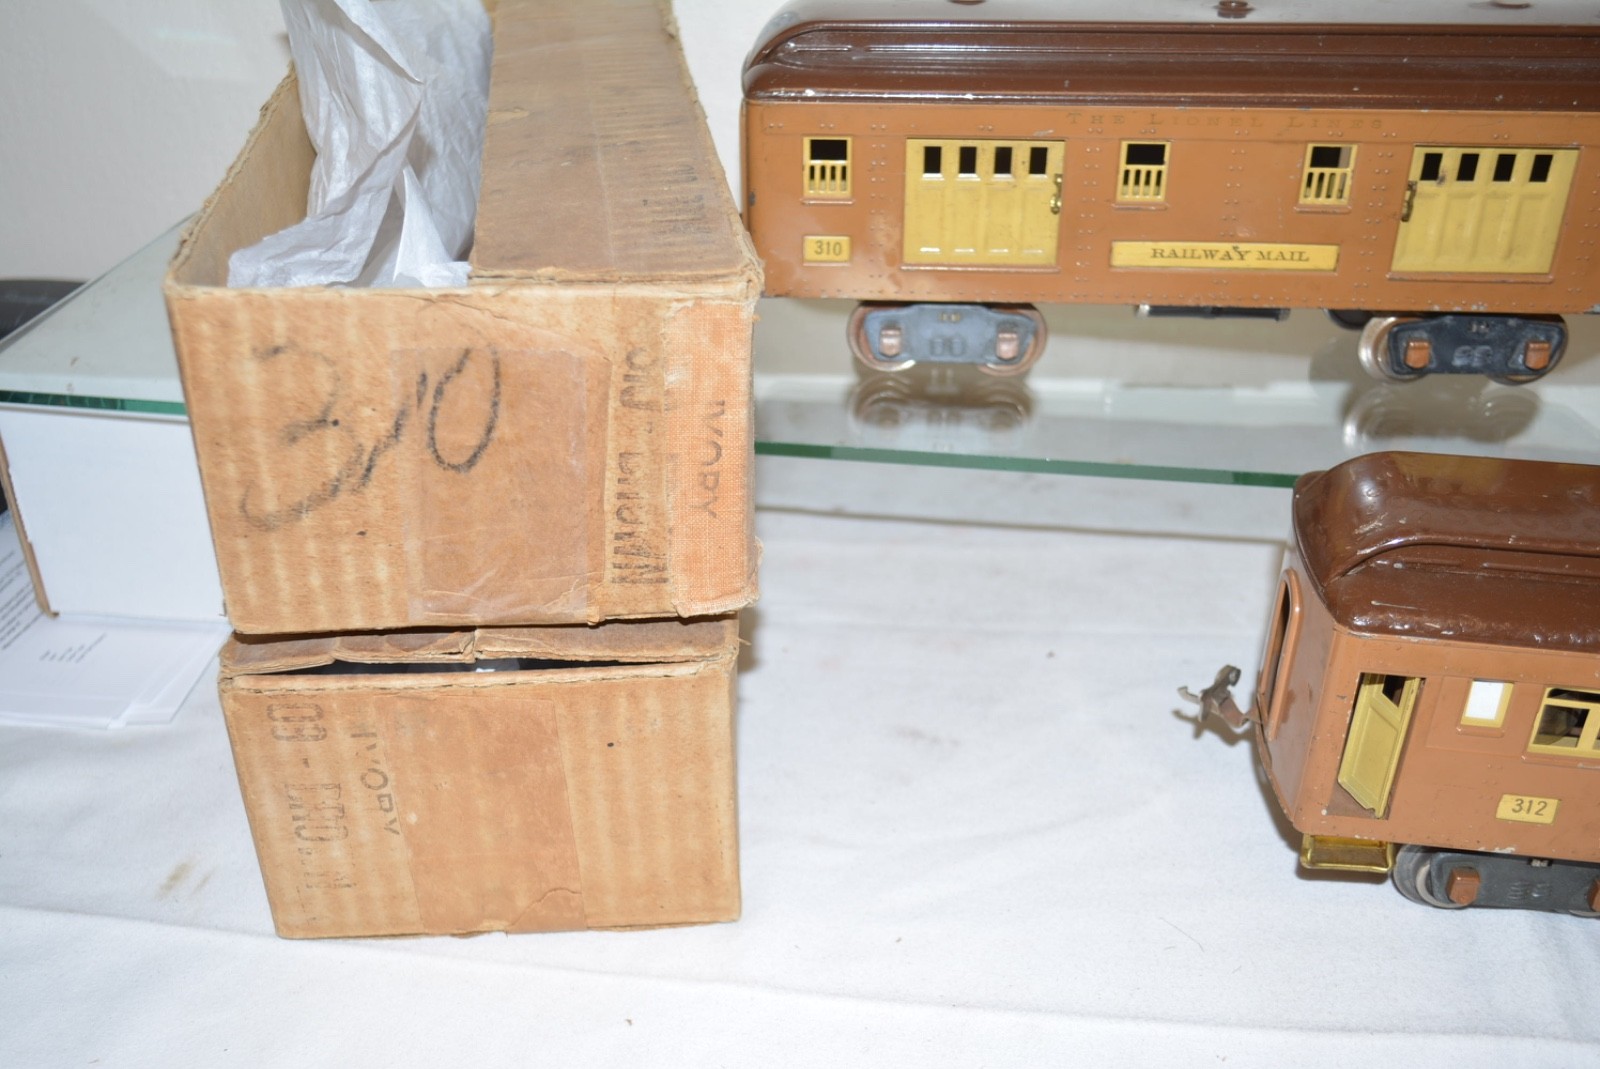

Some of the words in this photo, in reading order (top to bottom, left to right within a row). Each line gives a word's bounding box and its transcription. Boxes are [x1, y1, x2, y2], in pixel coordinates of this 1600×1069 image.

[1066, 112, 1126, 126] THE
[1148, 113, 1264, 129] LIONEL
[1287, 115, 1384, 130] LINES
[814, 240, 842, 256] 310
[1151, 247, 1251, 261] RAILWAY
[1256, 250, 1310, 262] MAIL
[240, 342, 501, 531] 310
[1511, 798, 1548, 816] 312
